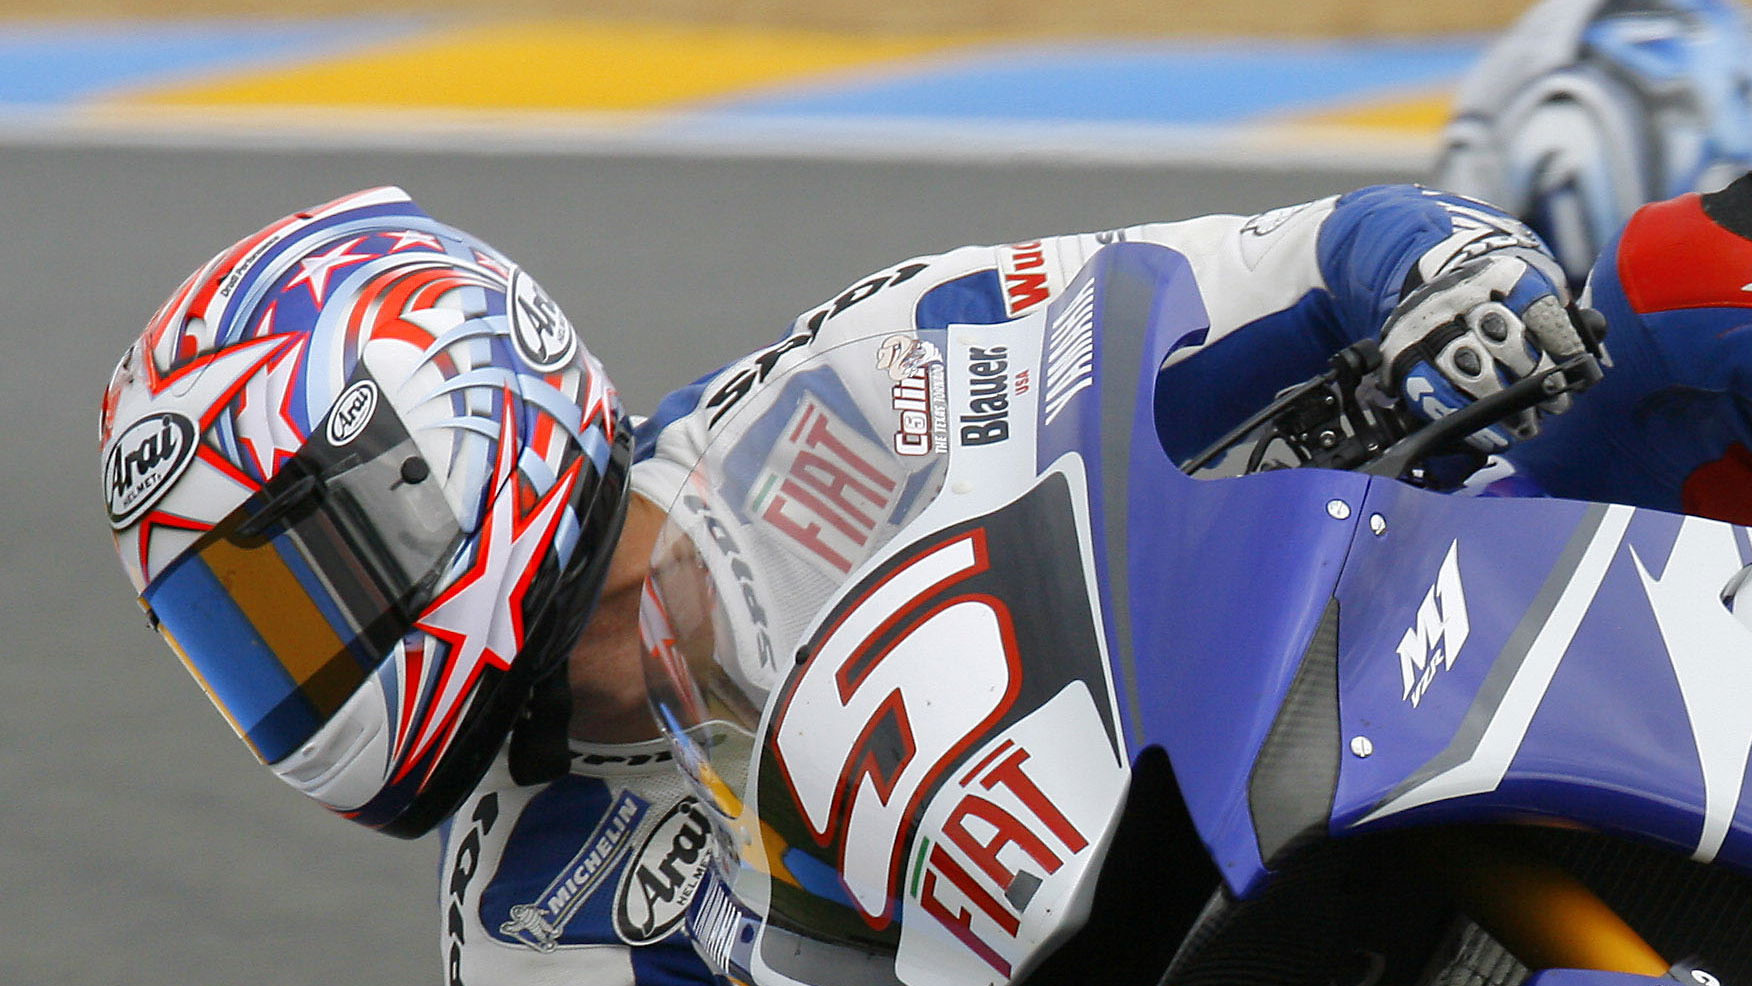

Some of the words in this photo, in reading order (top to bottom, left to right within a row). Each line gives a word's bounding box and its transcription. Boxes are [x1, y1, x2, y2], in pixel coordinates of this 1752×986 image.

[337, 388, 371, 431] Arai
[707, 263, 930, 431] SPIDI
[960, 346, 1009, 448] Blauer
[1015, 368, 1030, 396] USA
[1044, 277, 1095, 427] YAMAHA
[109, 414, 176, 494] Arai
[763, 413, 897, 574] FIAT
[772, 527, 1023, 929] 5
[547, 797, 638, 914] MICHELIN
[644, 802, 713, 936] Arai
[920, 747, 1090, 980] FIAT
